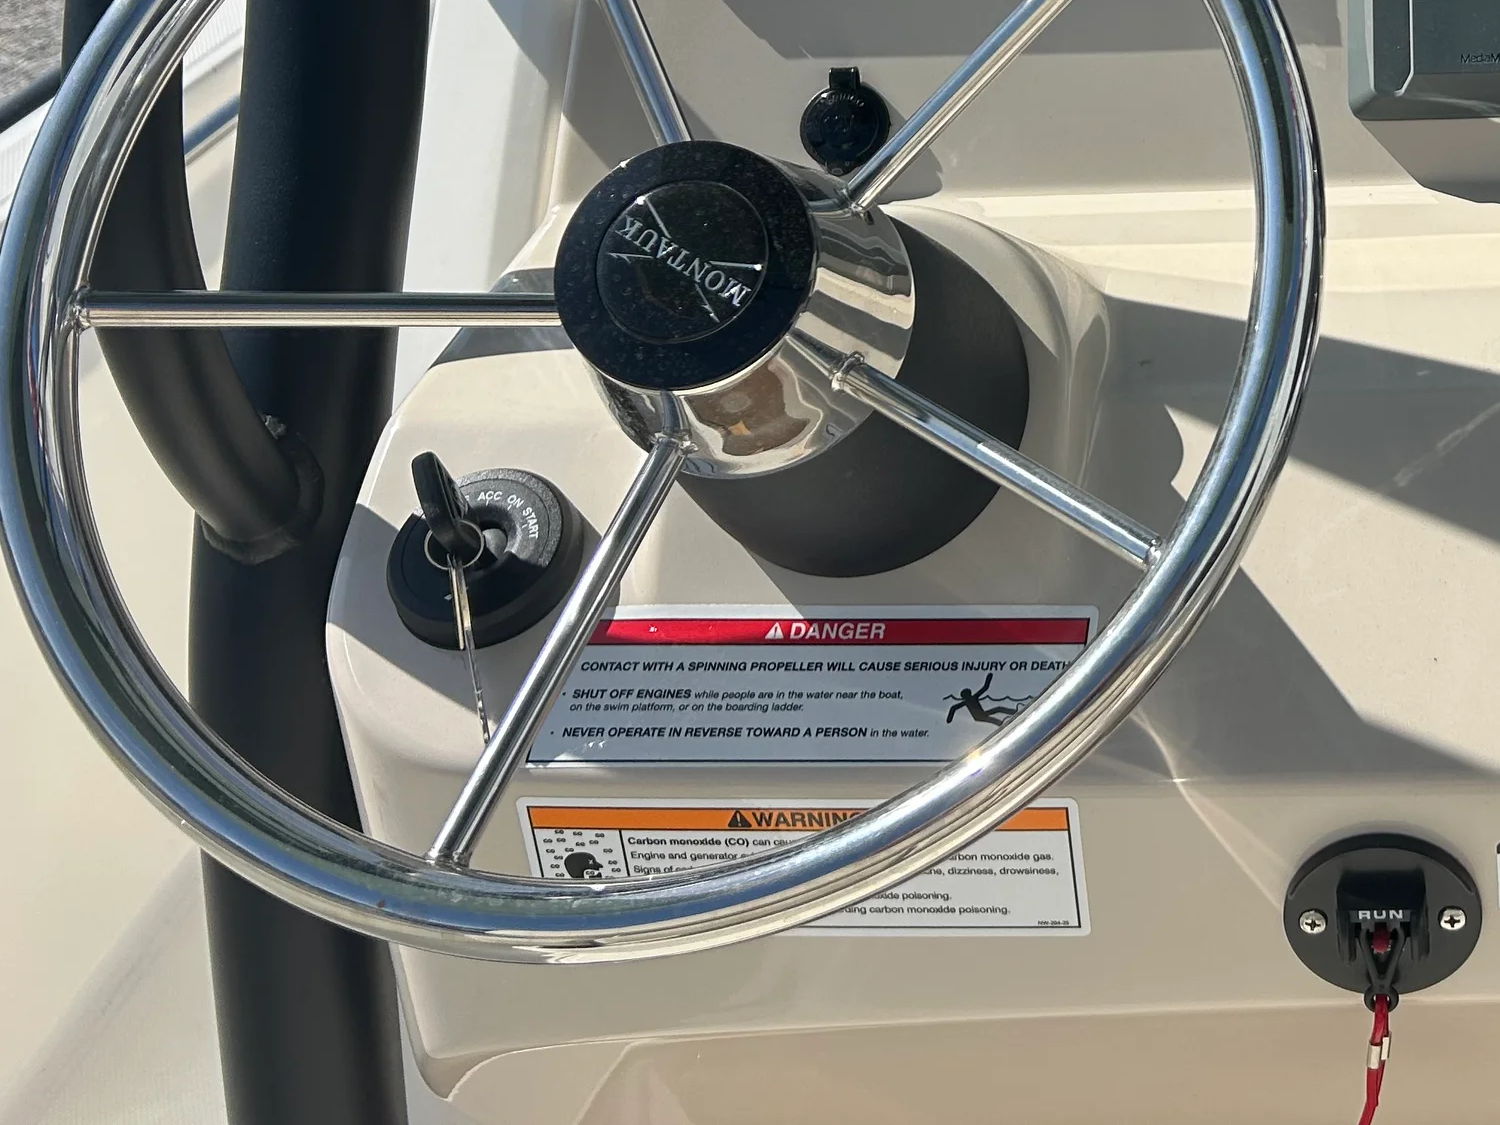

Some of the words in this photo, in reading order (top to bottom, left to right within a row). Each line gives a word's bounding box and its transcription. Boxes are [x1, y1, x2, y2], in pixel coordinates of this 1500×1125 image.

[615, 213, 752, 308] MONTAUK
[477, 490, 502, 502] ACC
[507, 494, 524, 508] ON
[522, 506, 539, 539] START
[789, 621, 886, 640] DANGER
[581, 661, 640, 672] CONTACT
[642, 661, 674, 672] WITH
[676, 661, 685, 672] A
[688, 661, 747, 672] SPINNING
[750, 661, 823, 672] PROPELLER
[827, 661, 855, 672] WILL
[858, 661, 901, 672] CAUSE
[904, 661, 959, 672] SERIOUS
[961, 661, 1006, 672] INJURY
[1009, 661, 1028, 672] OR
[572, 689, 608, 699] SHUT
[610, 689, 634, 699] OFF
[636, 689, 692, 699] ENGINES
[694, 690, 720, 699] while
[722, 690, 755, 702] people
[776, 690, 785, 699] in
[787, 690, 803, 699] the
[806, 691, 833, 700] water
[860, 690, 876, 699] the
[878, 690, 903, 700] boat,
[585, 702, 601, 711] the
[604, 702, 629, 712] swim
[631, 702, 676, 713] platform,
[707, 702, 723, 711] the
[725, 702, 769, 713] boarding
[771, 702, 804, 712] ladder.
[562, 727, 604, 737] NEVER
[607, 727, 665, 737] OPERATE
[668, 727, 681, 737] IN
[684, 727, 742, 737] REVERSE
[746, 727, 800, 737] TOWARD
[803, 727, 812, 737] A
[815, 727, 867, 737] PERSON
[870, 728, 880, 738] in
[882, 728, 897, 738] the
[900, 729, 930, 738] water.
[627, 837, 667, 846] Carbon
[669, 837, 722, 846] monoxide
[725, 837, 749, 848] (CO)
[630, 851, 666, 861] Engine
[668, 851, 687, 860] and
[690, 852, 738, 861] generator
[949, 852, 978, 861] arbon
[980, 852, 1030, 861] monoxide
[1033, 854, 1054, 863] gas.
[633, 865, 662, 874] Signs
[663, 865, 674, 874] of
[947, 867, 997, 877] dizziness,
[999, 866, 1059, 877] drowsiness,
[902, 891, 952, 902] poisoning.
[869, 905, 904, 914] carbon
[907, 905, 956, 914] monoxide
[958, 905, 1011, 916] poisoning.
[1357, 909, 1404, 920] RUN
